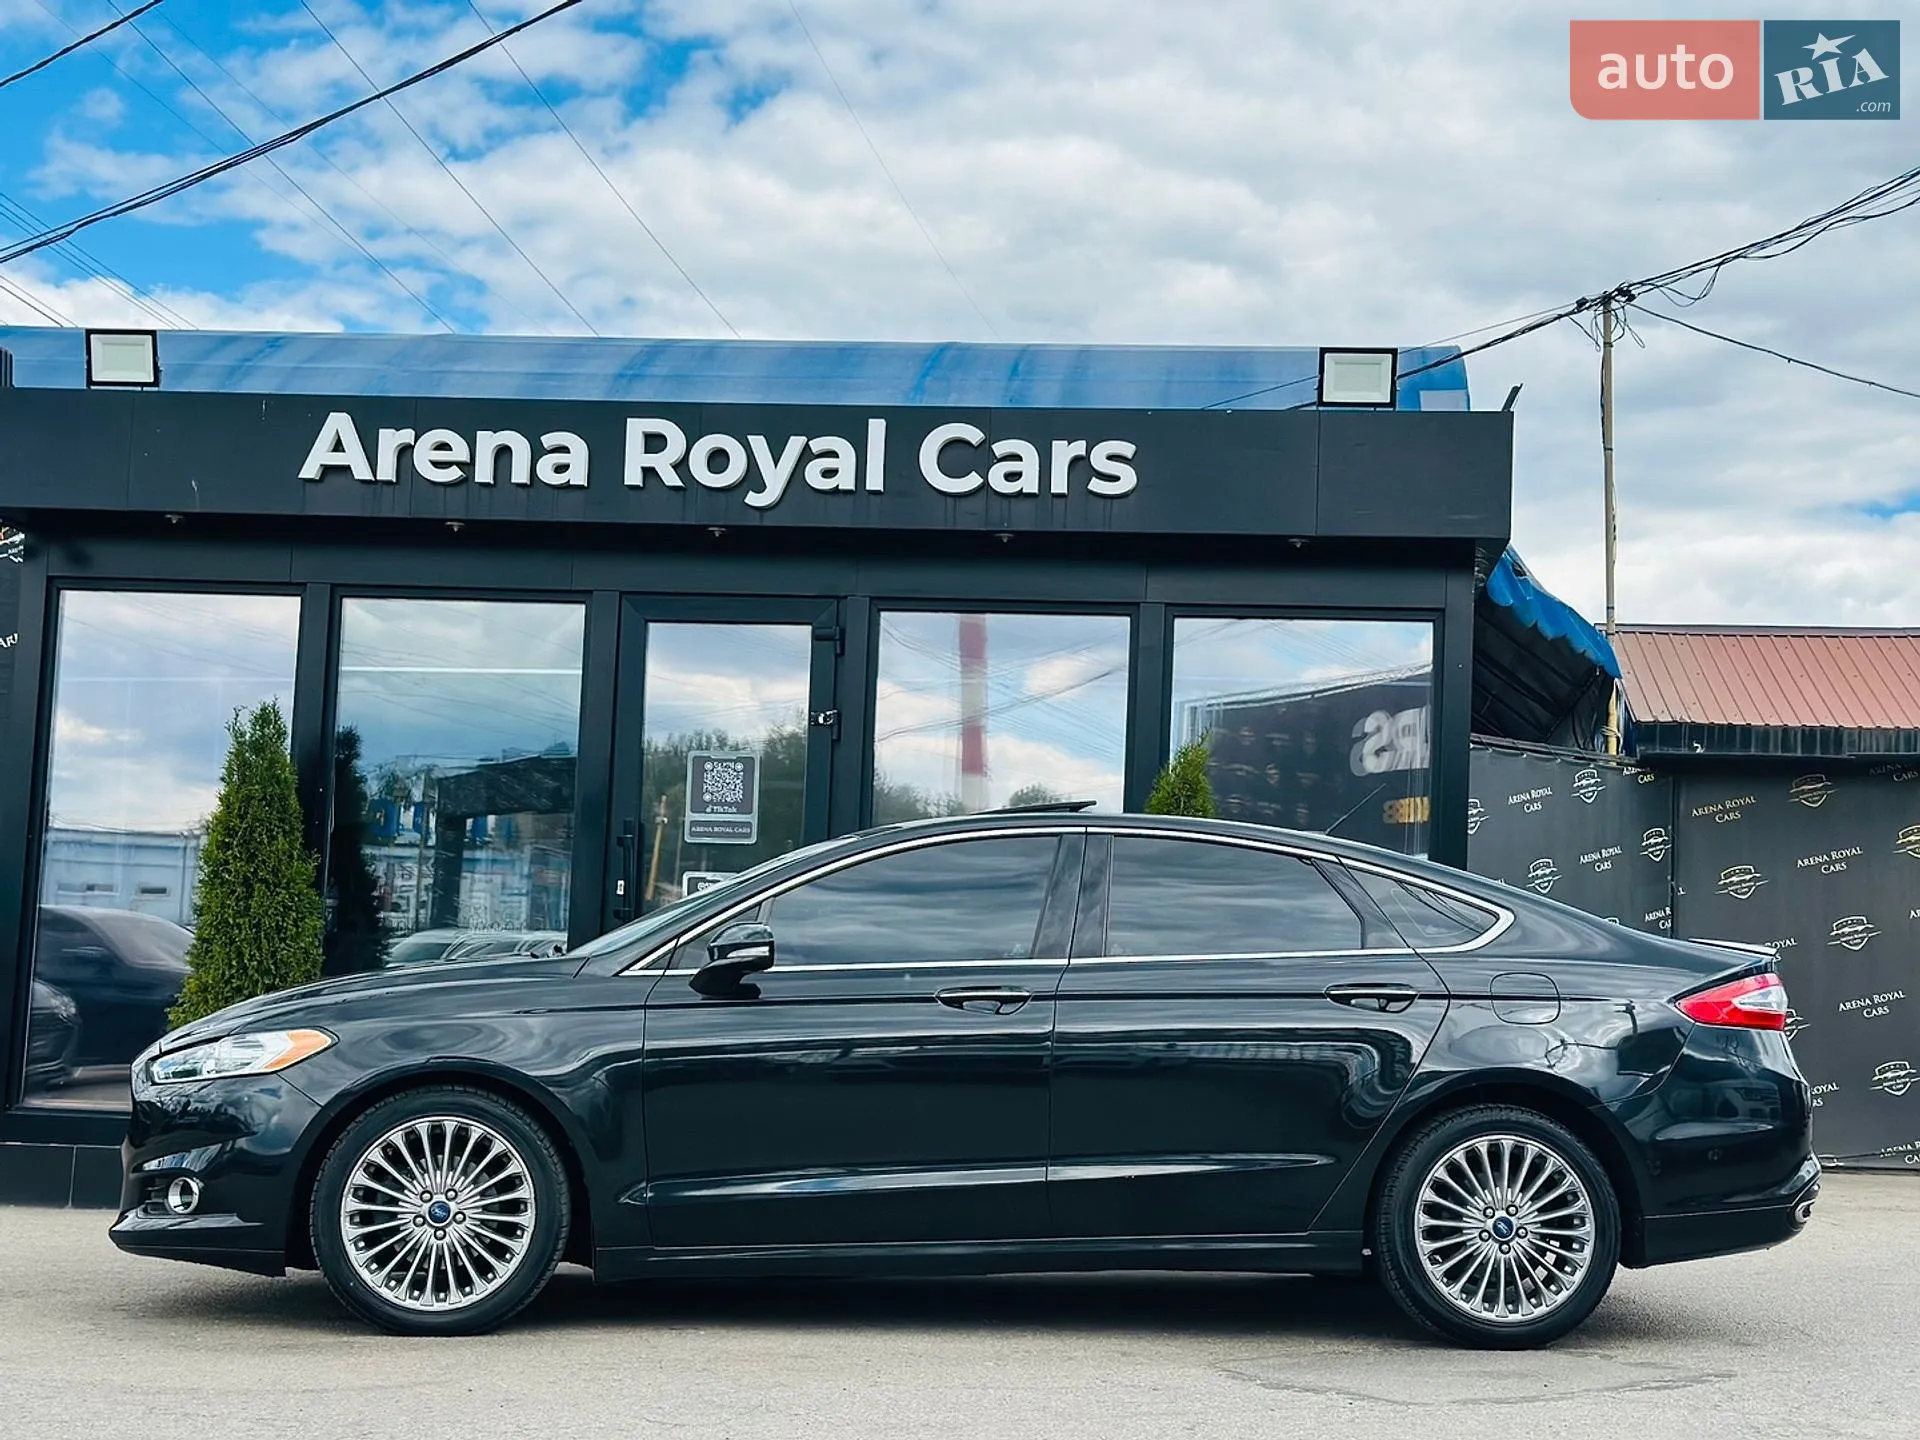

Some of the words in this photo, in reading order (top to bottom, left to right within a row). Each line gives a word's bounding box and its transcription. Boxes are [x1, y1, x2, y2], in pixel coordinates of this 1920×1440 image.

[297, 411, 590, 488] Arena
[622, 417, 888, 508] Royal
[917, 422, 1139, 498] Cars
[1507, 791, 1531, 805] ARENA
[1531, 786, 1553, 799] ROYAL
[1523, 801, 1542, 814] CARS
[1691, 803, 1723, 818] ARENA
[1725, 795, 1757, 810] ROYAL
[1714, 810, 1742, 824] CARS
[1579, 851, 1601, 865] ARENA
[1601, 845, 1623, 859] ROYAL
[1796, 853, 1830, 869] ARENA
[1831, 846, 1864, 861] ROYAL
[1594, 860, 1612, 873] CARS
[1820, 861, 1848, 875] CARS
[1838, 997, 1873, 1013] ARENA
[1873, 990, 1907, 1005] ROYAL
[1862, 1005, 1890, 1019] CARS
[1904, 1154, 1920, 1165] CA
